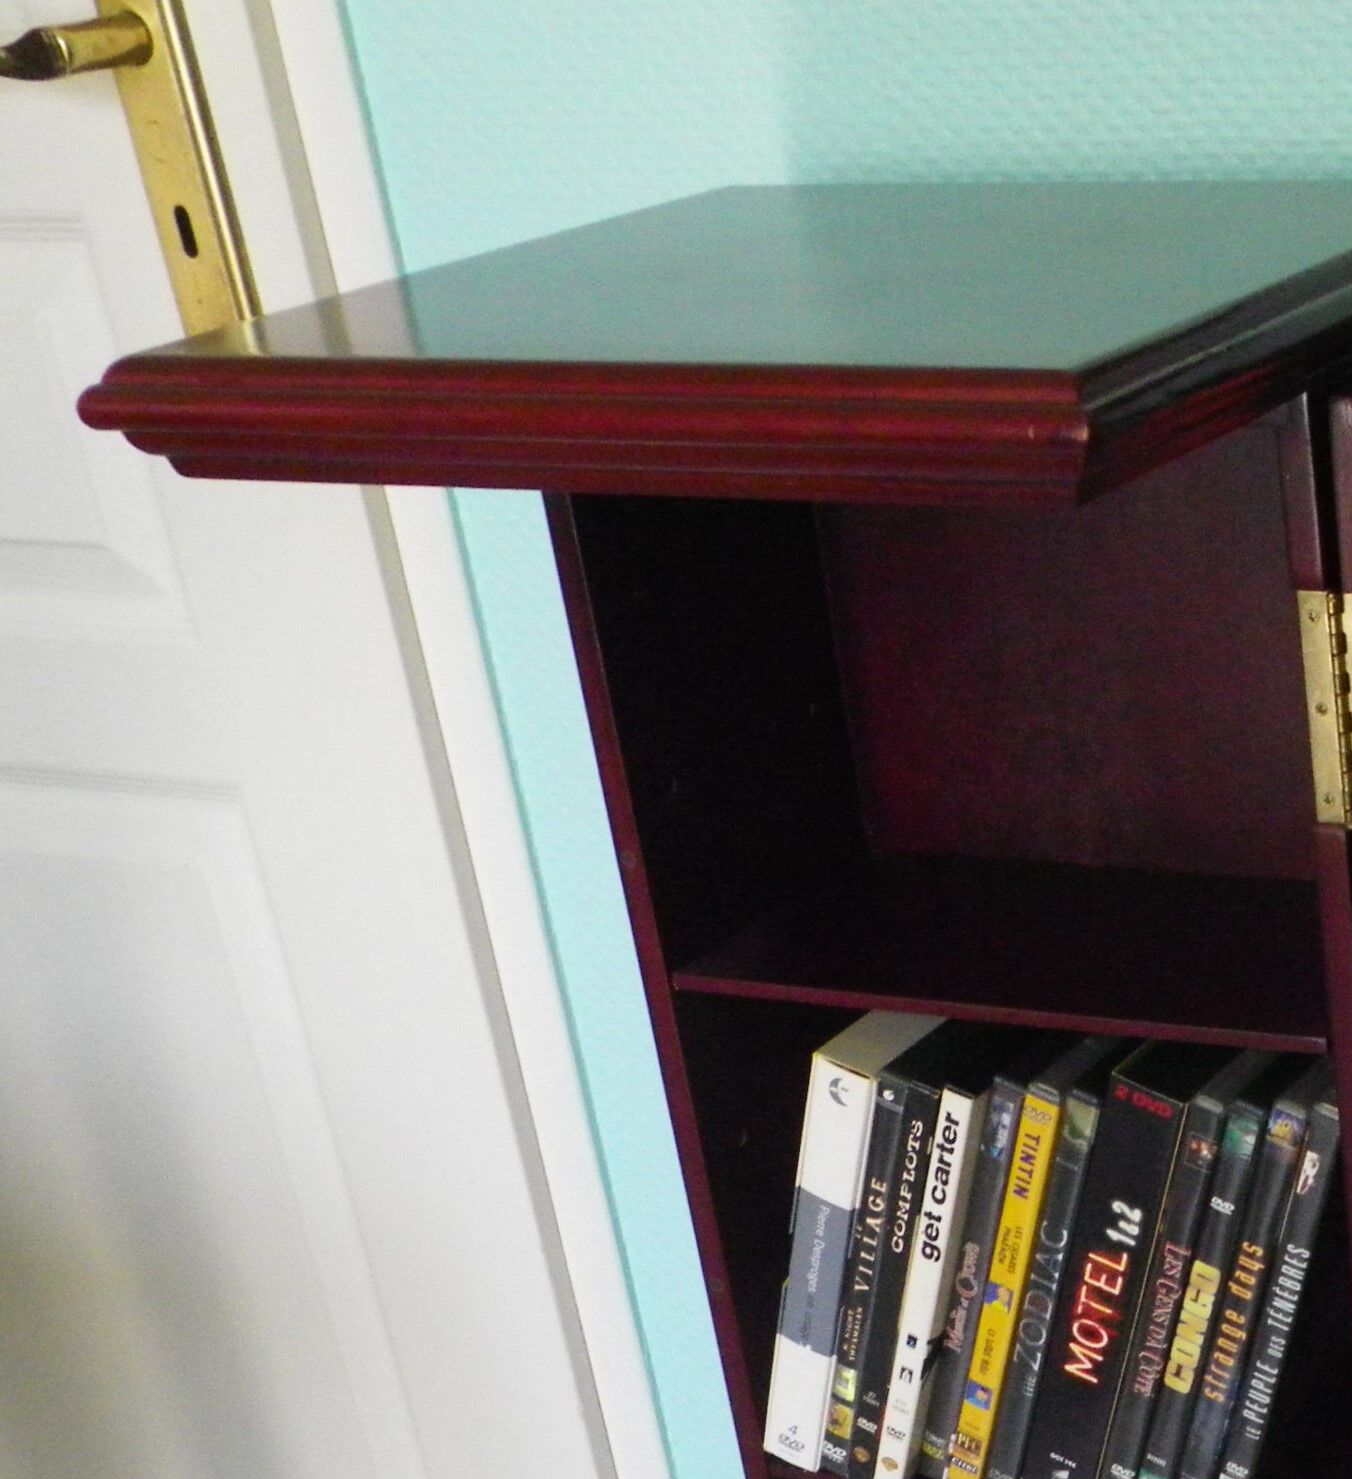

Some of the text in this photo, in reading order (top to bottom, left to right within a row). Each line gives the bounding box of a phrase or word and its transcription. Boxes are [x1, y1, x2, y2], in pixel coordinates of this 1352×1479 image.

[891, 1119, 923, 1254] COMPLOTS
[922, 1112, 961, 1262] get carter
[1012, 1130, 1041, 1200] TINTIN
[854, 1177, 888, 1293] VILLAGE
[1014, 1220, 1068, 1373] ZODIAC
[1063, 1251, 1128, 1385] MOTEL
[1164, 1259, 1221, 1394] CONGO
[1203, 1240, 1265, 1403] strange days
[1243, 1360, 1278, 1425] PEUPLE
[1268, 1243, 1311, 1331] TÉNÈBRES
